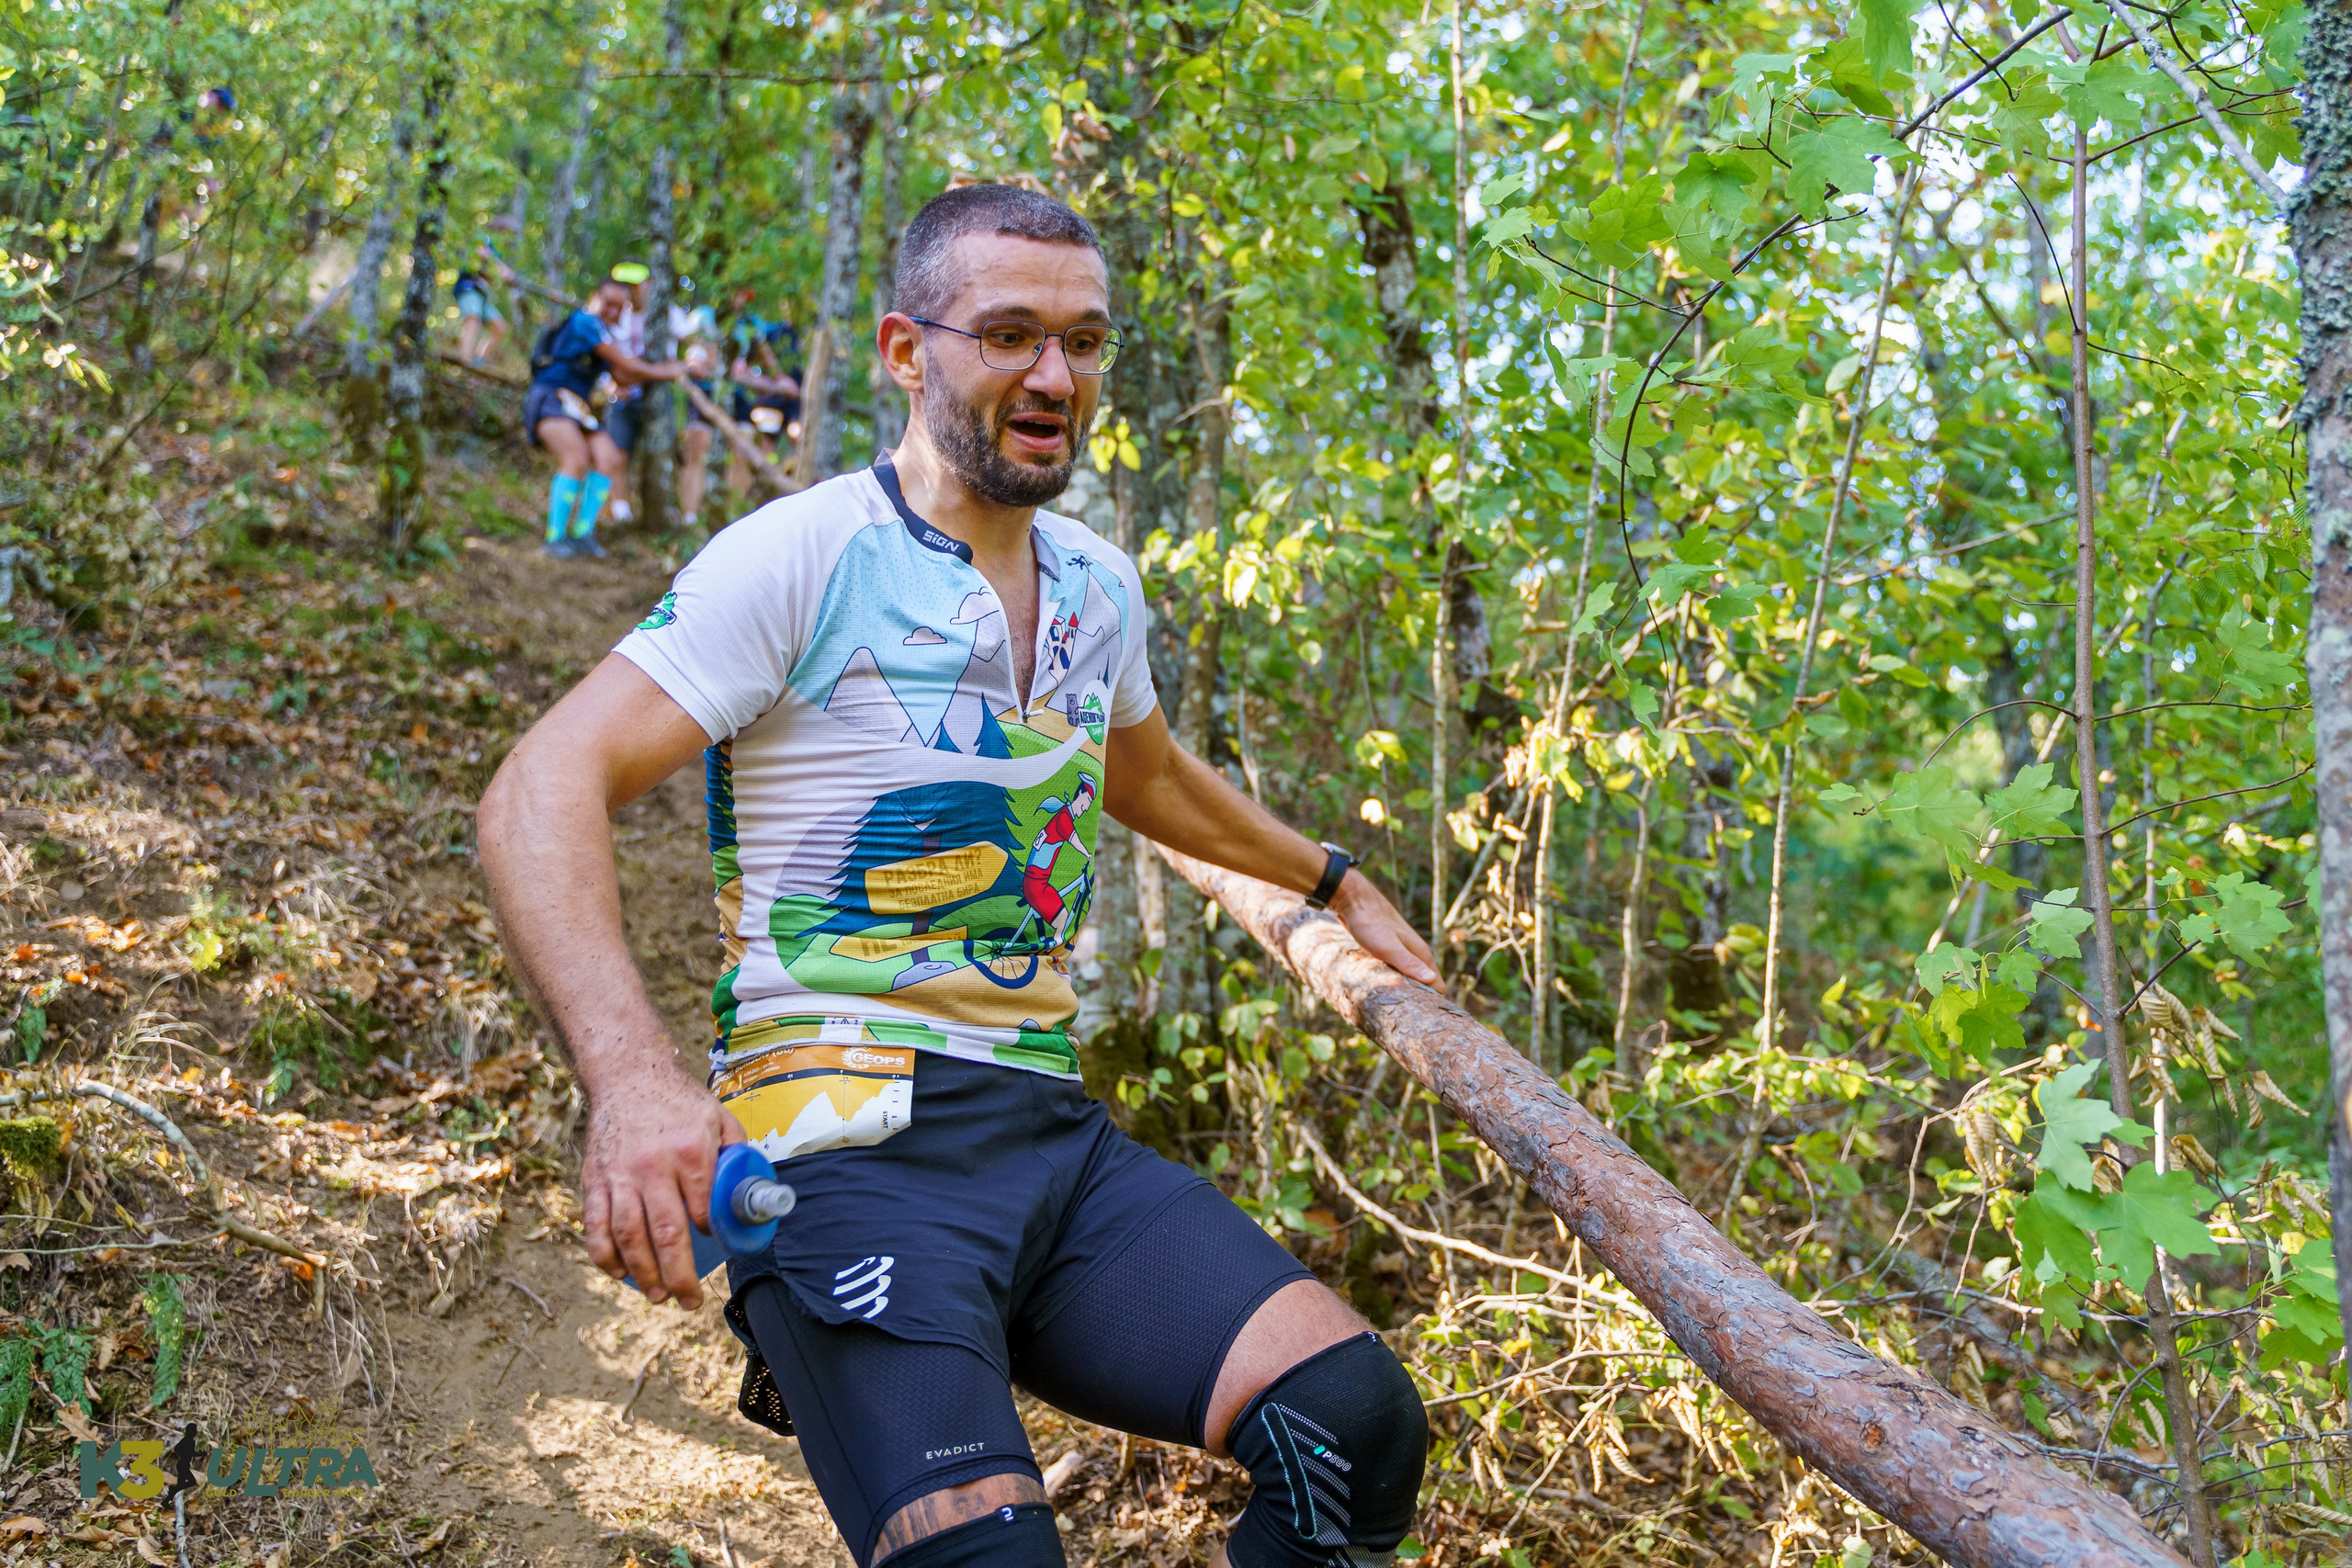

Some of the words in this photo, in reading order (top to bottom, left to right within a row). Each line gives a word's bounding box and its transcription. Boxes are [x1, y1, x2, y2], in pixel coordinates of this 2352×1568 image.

[883, 858, 948, 887] РАЗБРА
[955, 848, 982, 872] ЛИ?
[888, 887, 903, 899] ЗА
[905, 874, 963, 897] ПОСЛЕДНИЯ
[964, 867, 984, 883] ИМА
[898, 890, 956, 910] БЕЗПЛАТНА
[956, 882, 980, 897] БИРА
[852, 1052, 906, 1066] GEOPS
[925, 1442, 985, 1460] EVADICT
[1322, 1450, 1352, 1472] P500
